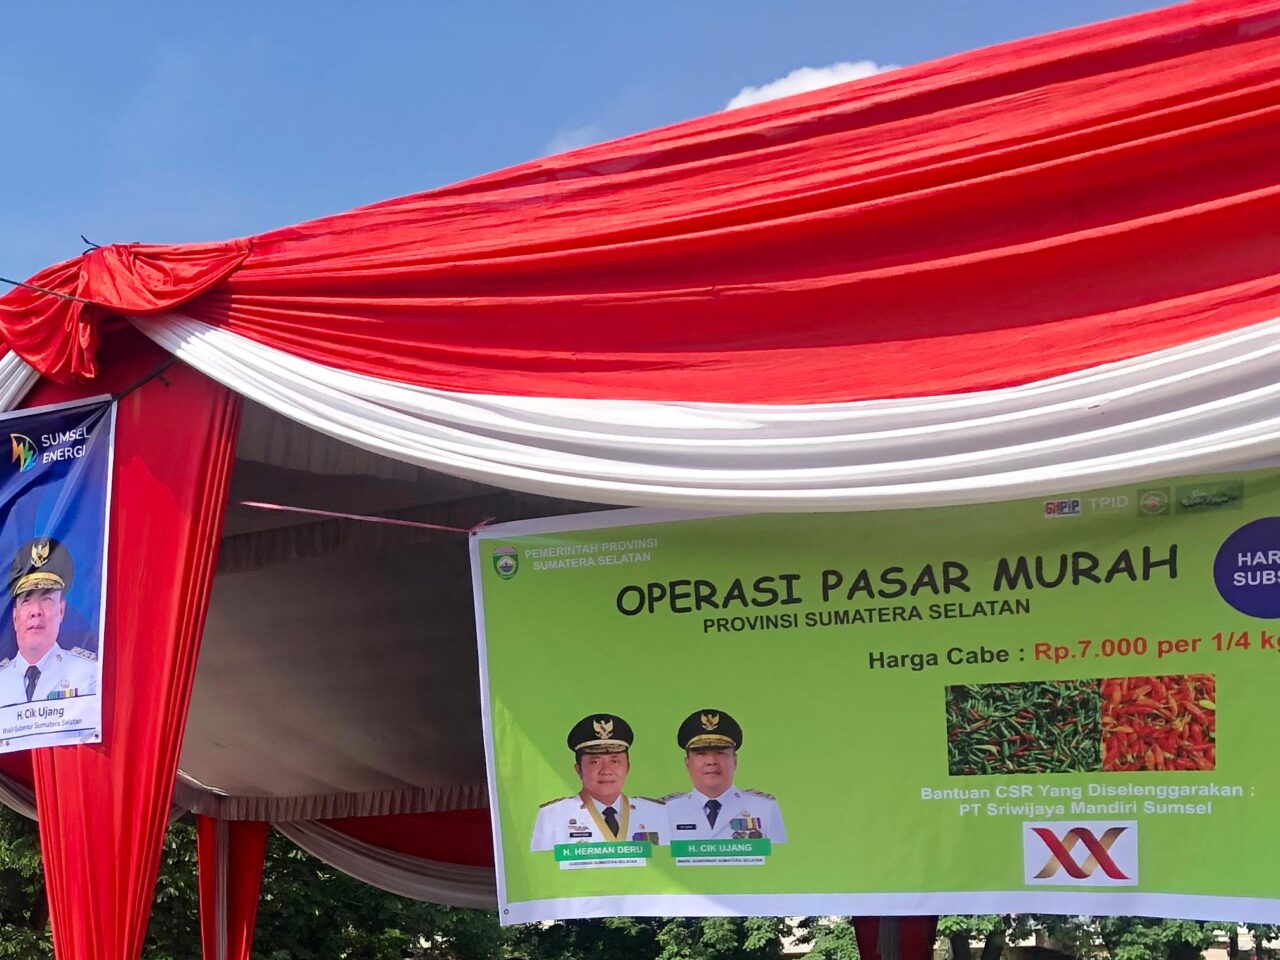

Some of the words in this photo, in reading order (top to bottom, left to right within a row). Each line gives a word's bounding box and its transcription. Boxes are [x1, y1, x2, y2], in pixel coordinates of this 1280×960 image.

[41, 427, 91, 447] SUMSEL
[42, 445, 86, 464] ENERGI
[1088, 496, 1129, 511] TPID
[525, 544, 598, 559] PEMERINTAH
[601, 538, 658, 553] PROVINSI
[533, 557, 595, 570] SUMATERA
[597, 552, 651, 566] SELATAN
[615, 574, 802, 616] OPERASI
[821, 561, 971, 603] PASAR
[993, 544, 1178, 592] MURAH
[1233, 571, 1280, 587] SUB
[703, 613, 799, 633] PROVINSI
[805, 606, 924, 627] SUMATERA
[928, 599, 1030, 621] SELATAN
[868, 647, 939, 671] Harga
[946, 646, 1010, 665] Cabe
[1034, 636, 1148, 663] Rp.7.000
[1157, 637, 1202, 659] per
[1212, 631, 1251, 652] 1/4
[24, 708, 36, 719] Cik
[38, 706, 64, 719] Ujang
[920, 786, 990, 800] Bantuan
[995, 785, 1033, 799] CSR
[1039, 784, 1083, 800] Yang
[1088, 783, 1244, 800] Diselenggarakan
[959, 803, 981, 816] PT
[986, 802, 1065, 818] Sriwijaya
[1071, 801, 1137, 815] Mandiri
[1144, 801, 1212, 815] Sumsel
[563, 848, 573, 856] H.
[574, 846, 615, 856] HERMAN
[617, 845, 643, 854] DERU
[688, 844, 698, 852] H.
[700, 844, 717, 852] CIK
[719, 843, 753, 852] UJANG
